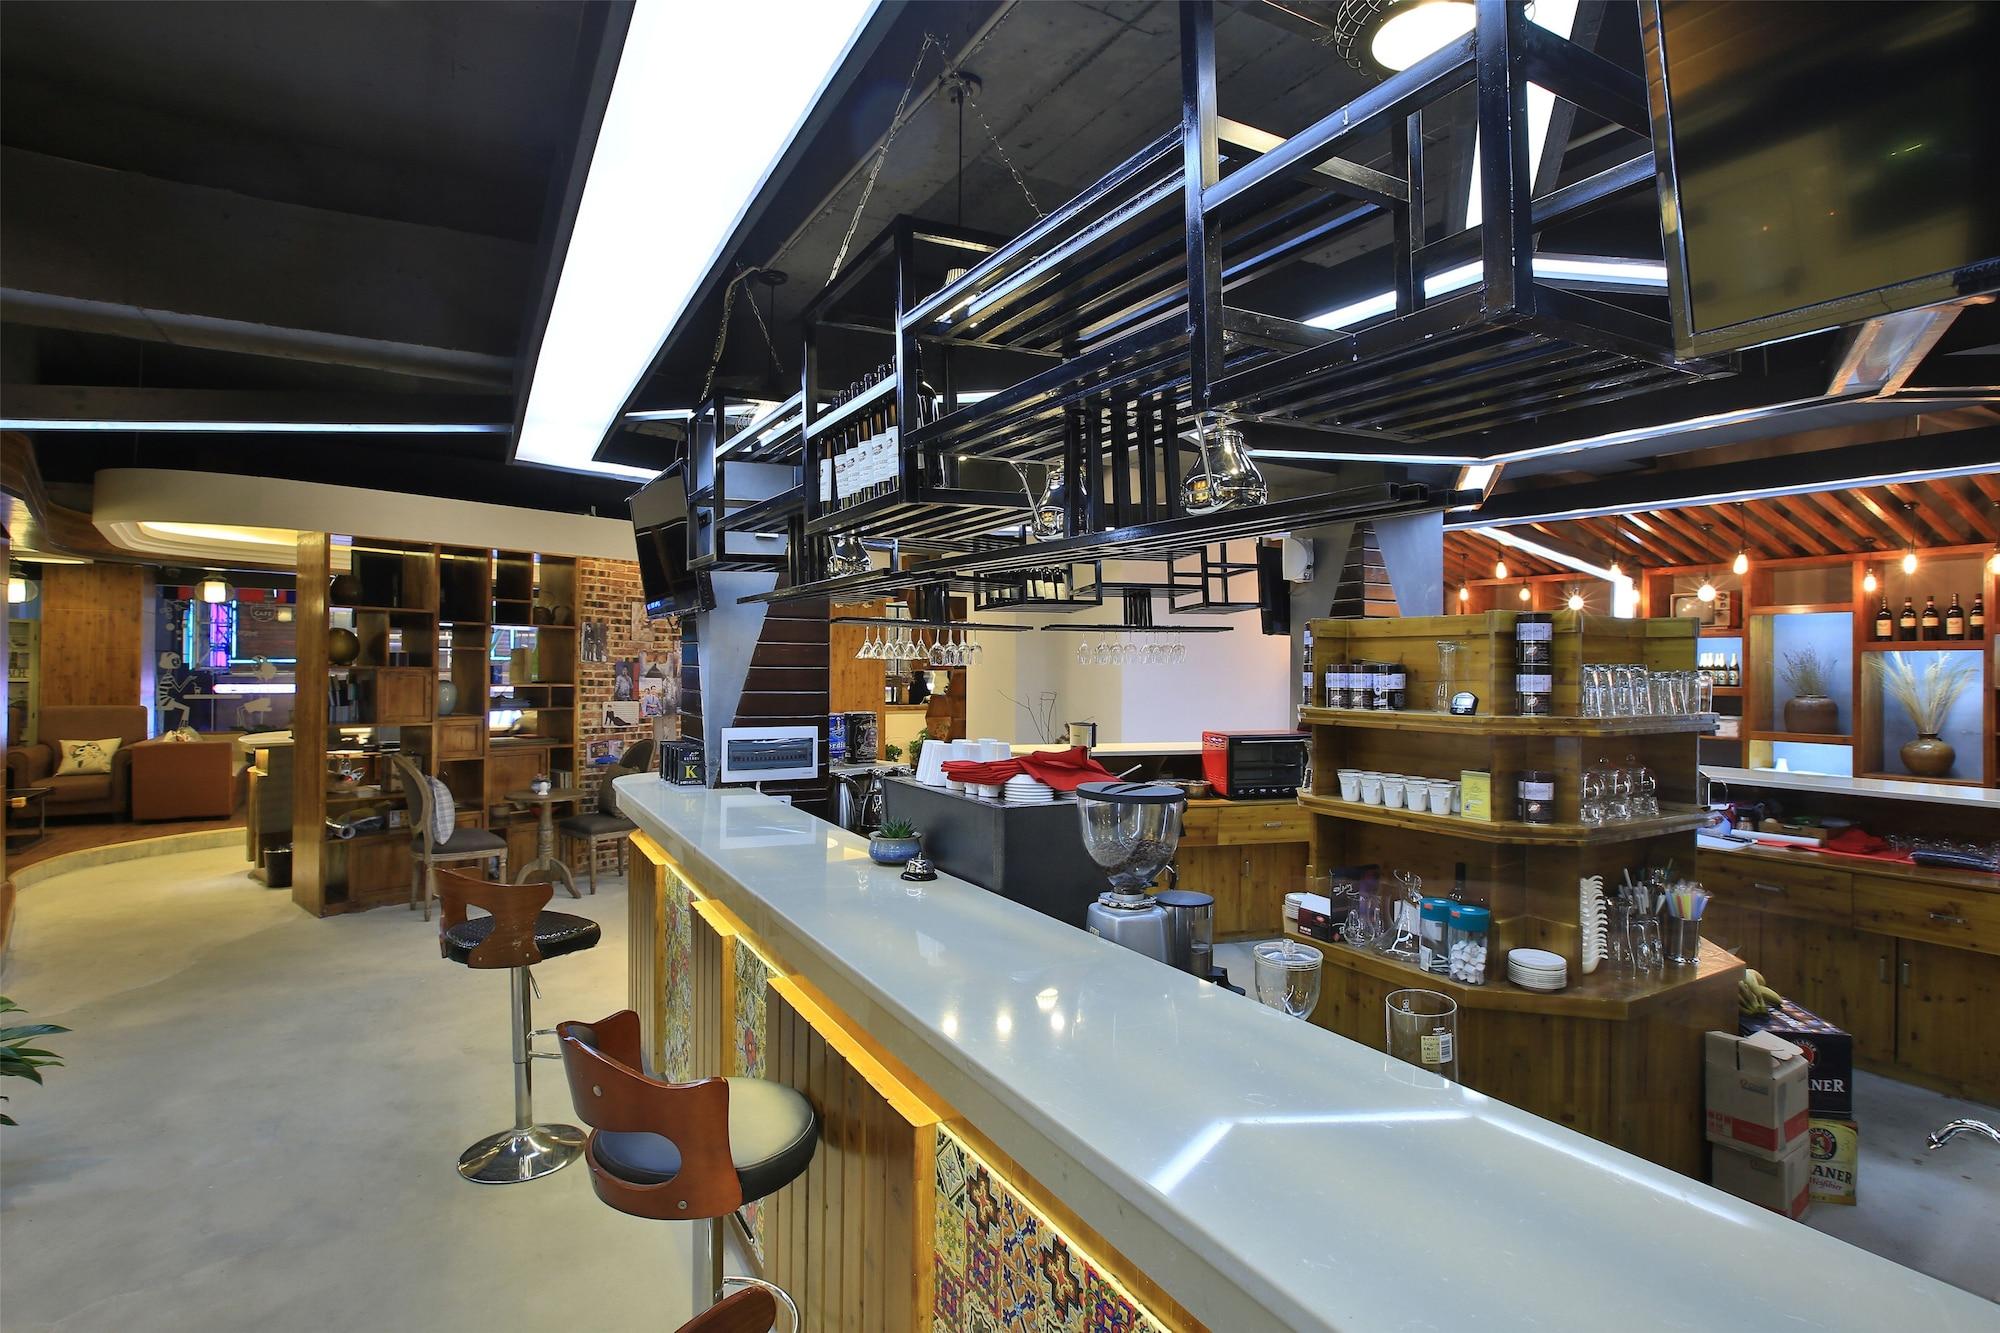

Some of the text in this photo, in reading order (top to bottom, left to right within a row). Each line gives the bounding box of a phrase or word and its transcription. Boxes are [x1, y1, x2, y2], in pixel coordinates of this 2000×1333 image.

[685, 765, 698, 779] K
[1808, 1079, 1845, 1093] NER
[1811, 1164, 1853, 1185] ANER
